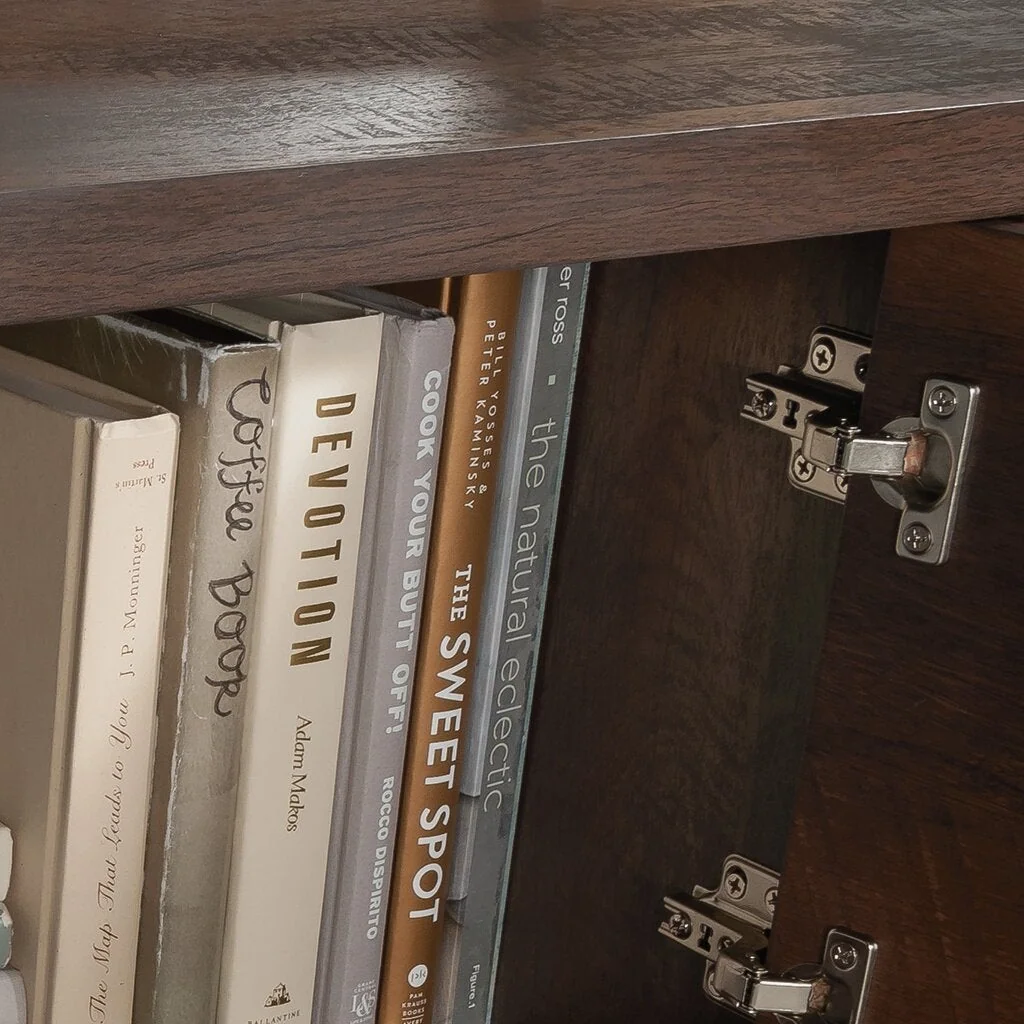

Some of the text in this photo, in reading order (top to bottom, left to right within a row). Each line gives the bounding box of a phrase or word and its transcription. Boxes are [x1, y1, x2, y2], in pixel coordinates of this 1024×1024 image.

[551, 297, 568, 345] ross
[133, 457, 156, 470] Press
[217, 367, 271, 542] Coffee
[464, 319, 496, 509] PETER KAMINSKY
[479, 331, 506, 494] BILL YOSSES &
[525, 417, 558, 490] the
[124, 526, 146, 629] Monninger
[290, 393, 356, 667] DEVOTION
[385, 370, 442, 734] COOK YOUR BUTT OFF!
[505, 502, 542, 643] natural
[287, 714, 313, 832] Adam Makos
[408, 564, 473, 923] THE SWEET SPOT
[483, 657, 522, 812] eclectic
[88, 699, 133, 1024] The Map That Leads to You
[366, 775, 395, 940] ROCCO DISPIRITO
